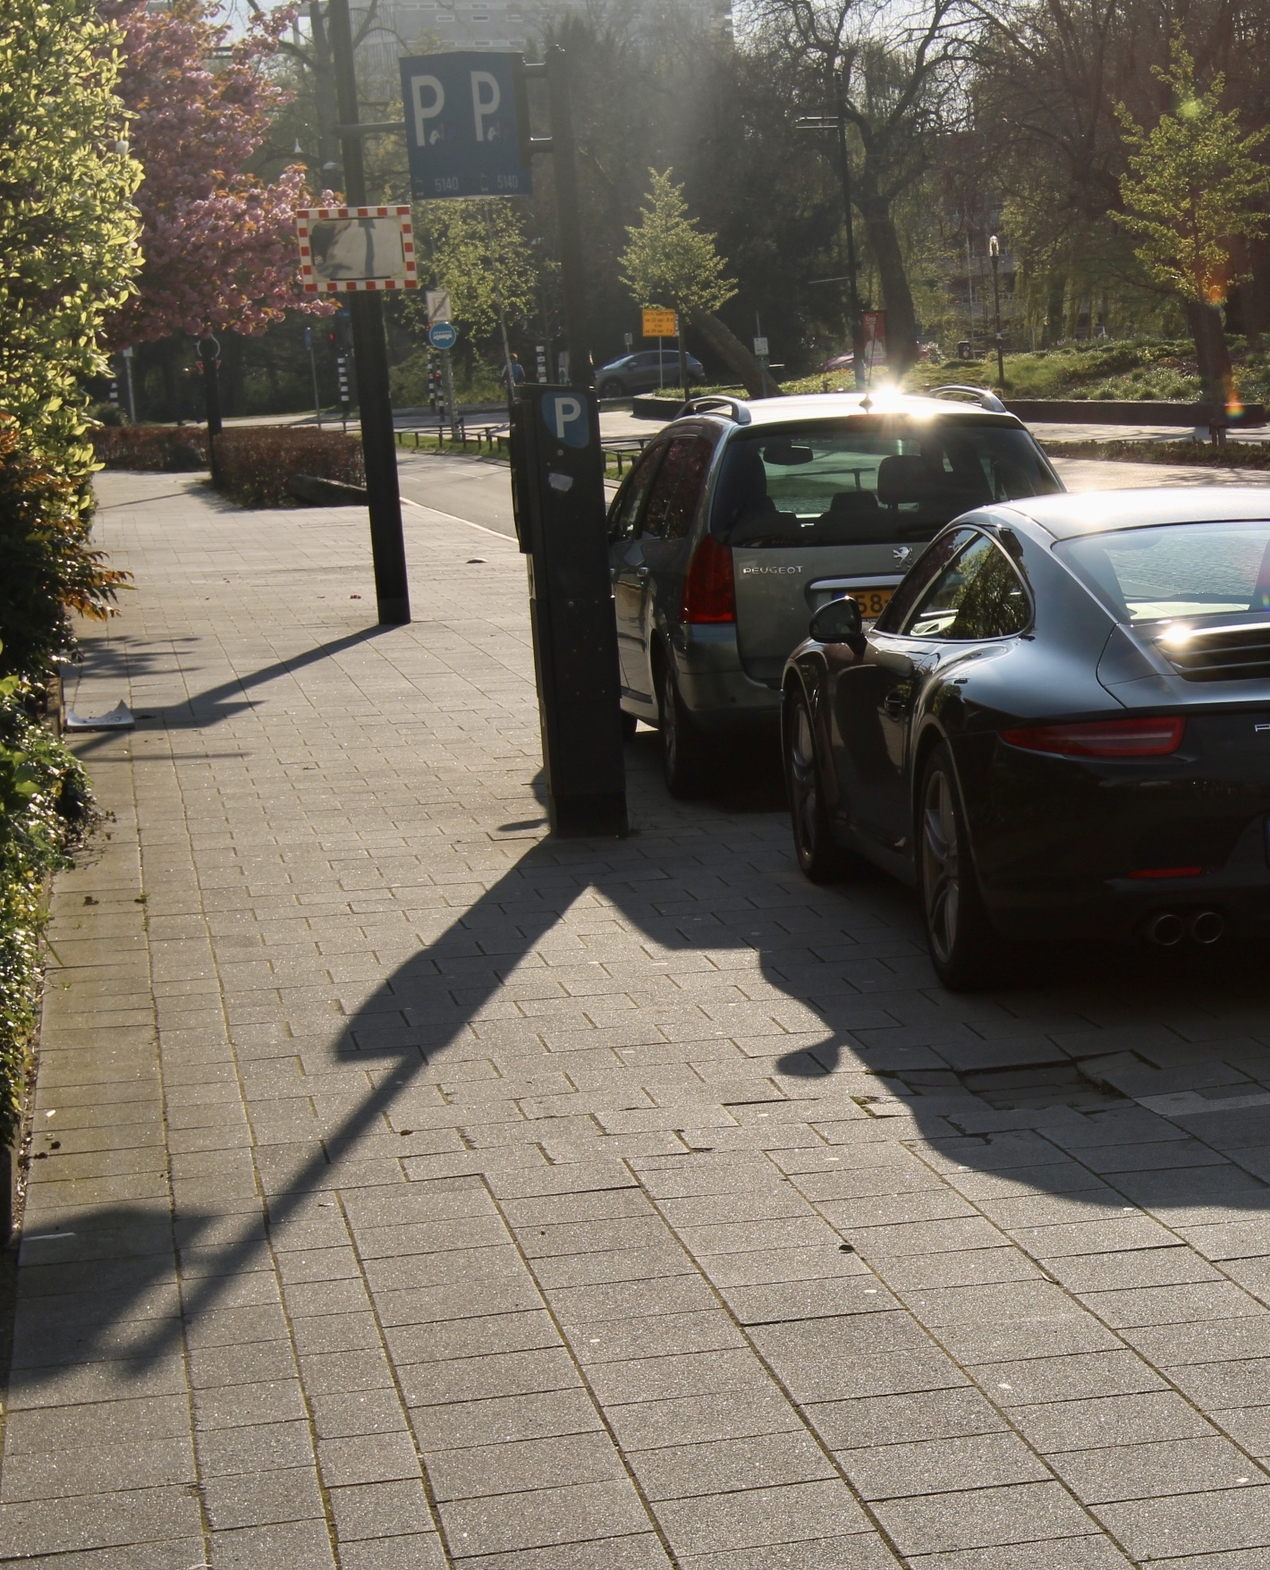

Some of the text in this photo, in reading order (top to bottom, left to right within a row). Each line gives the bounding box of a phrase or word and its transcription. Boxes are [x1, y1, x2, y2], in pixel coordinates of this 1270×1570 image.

[410, 71, 500, 146] P P
[434, 175, 519, 192] 5140 5140
[554, 397, 581, 438] P
[743, 565, 803, 575] PEUGEOT
